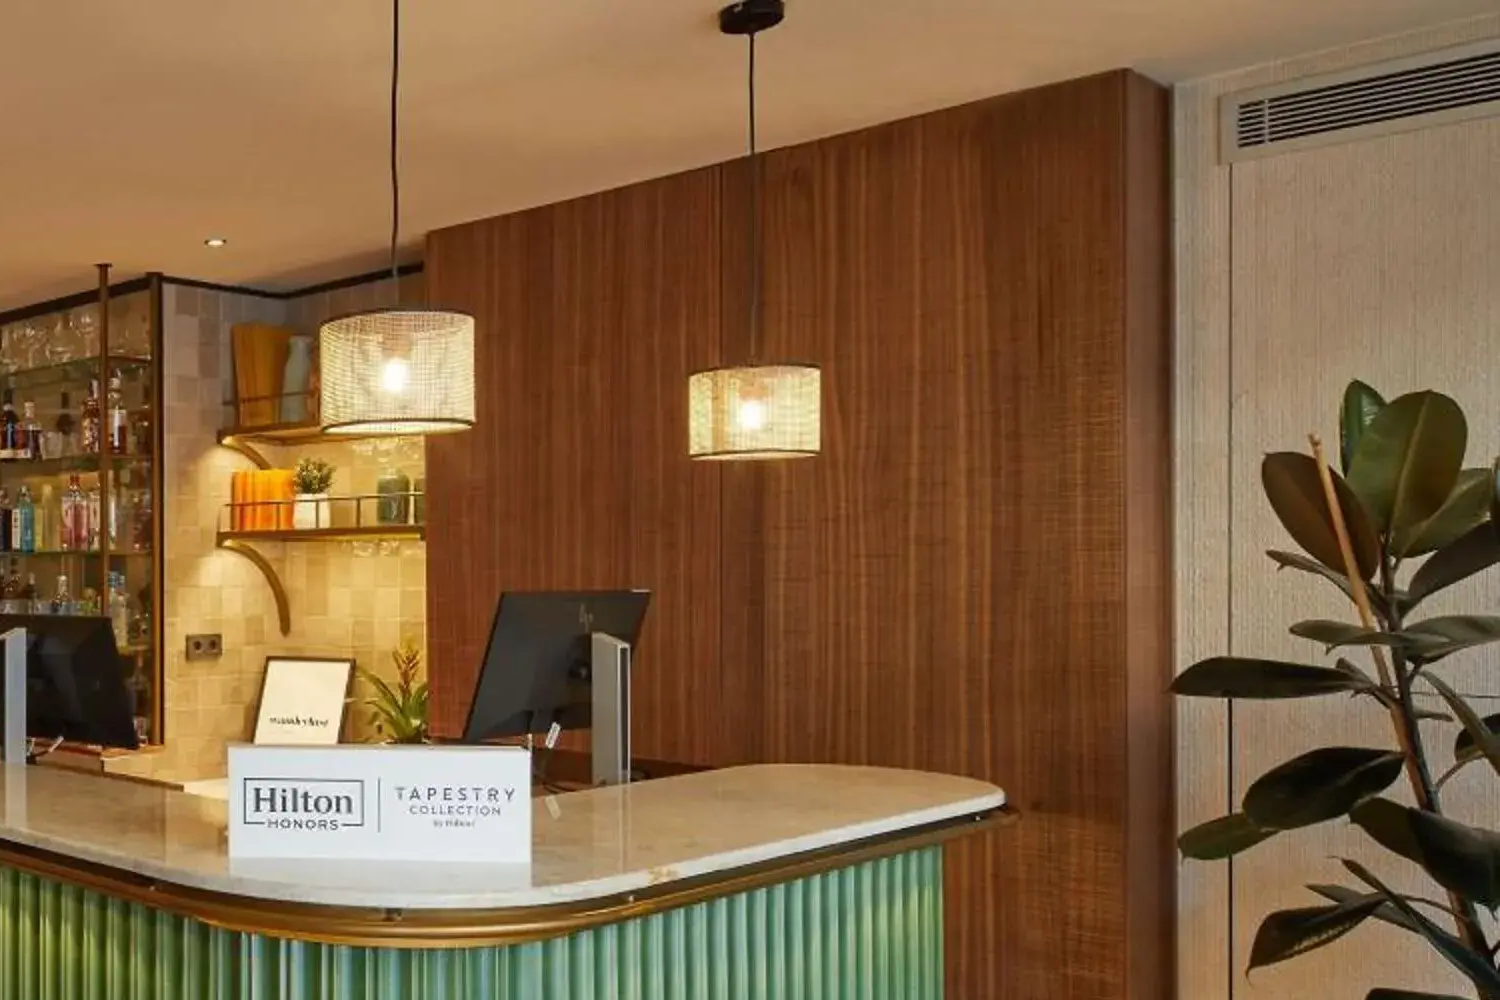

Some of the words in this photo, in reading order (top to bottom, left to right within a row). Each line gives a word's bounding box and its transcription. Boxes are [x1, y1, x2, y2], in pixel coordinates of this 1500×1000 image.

[253, 787, 353, 814] Hilton
[395, 786, 515, 802] TAPESTRY
[409, 805, 501, 816] COLLECTION
[267, 819, 339, 830] HONORS
